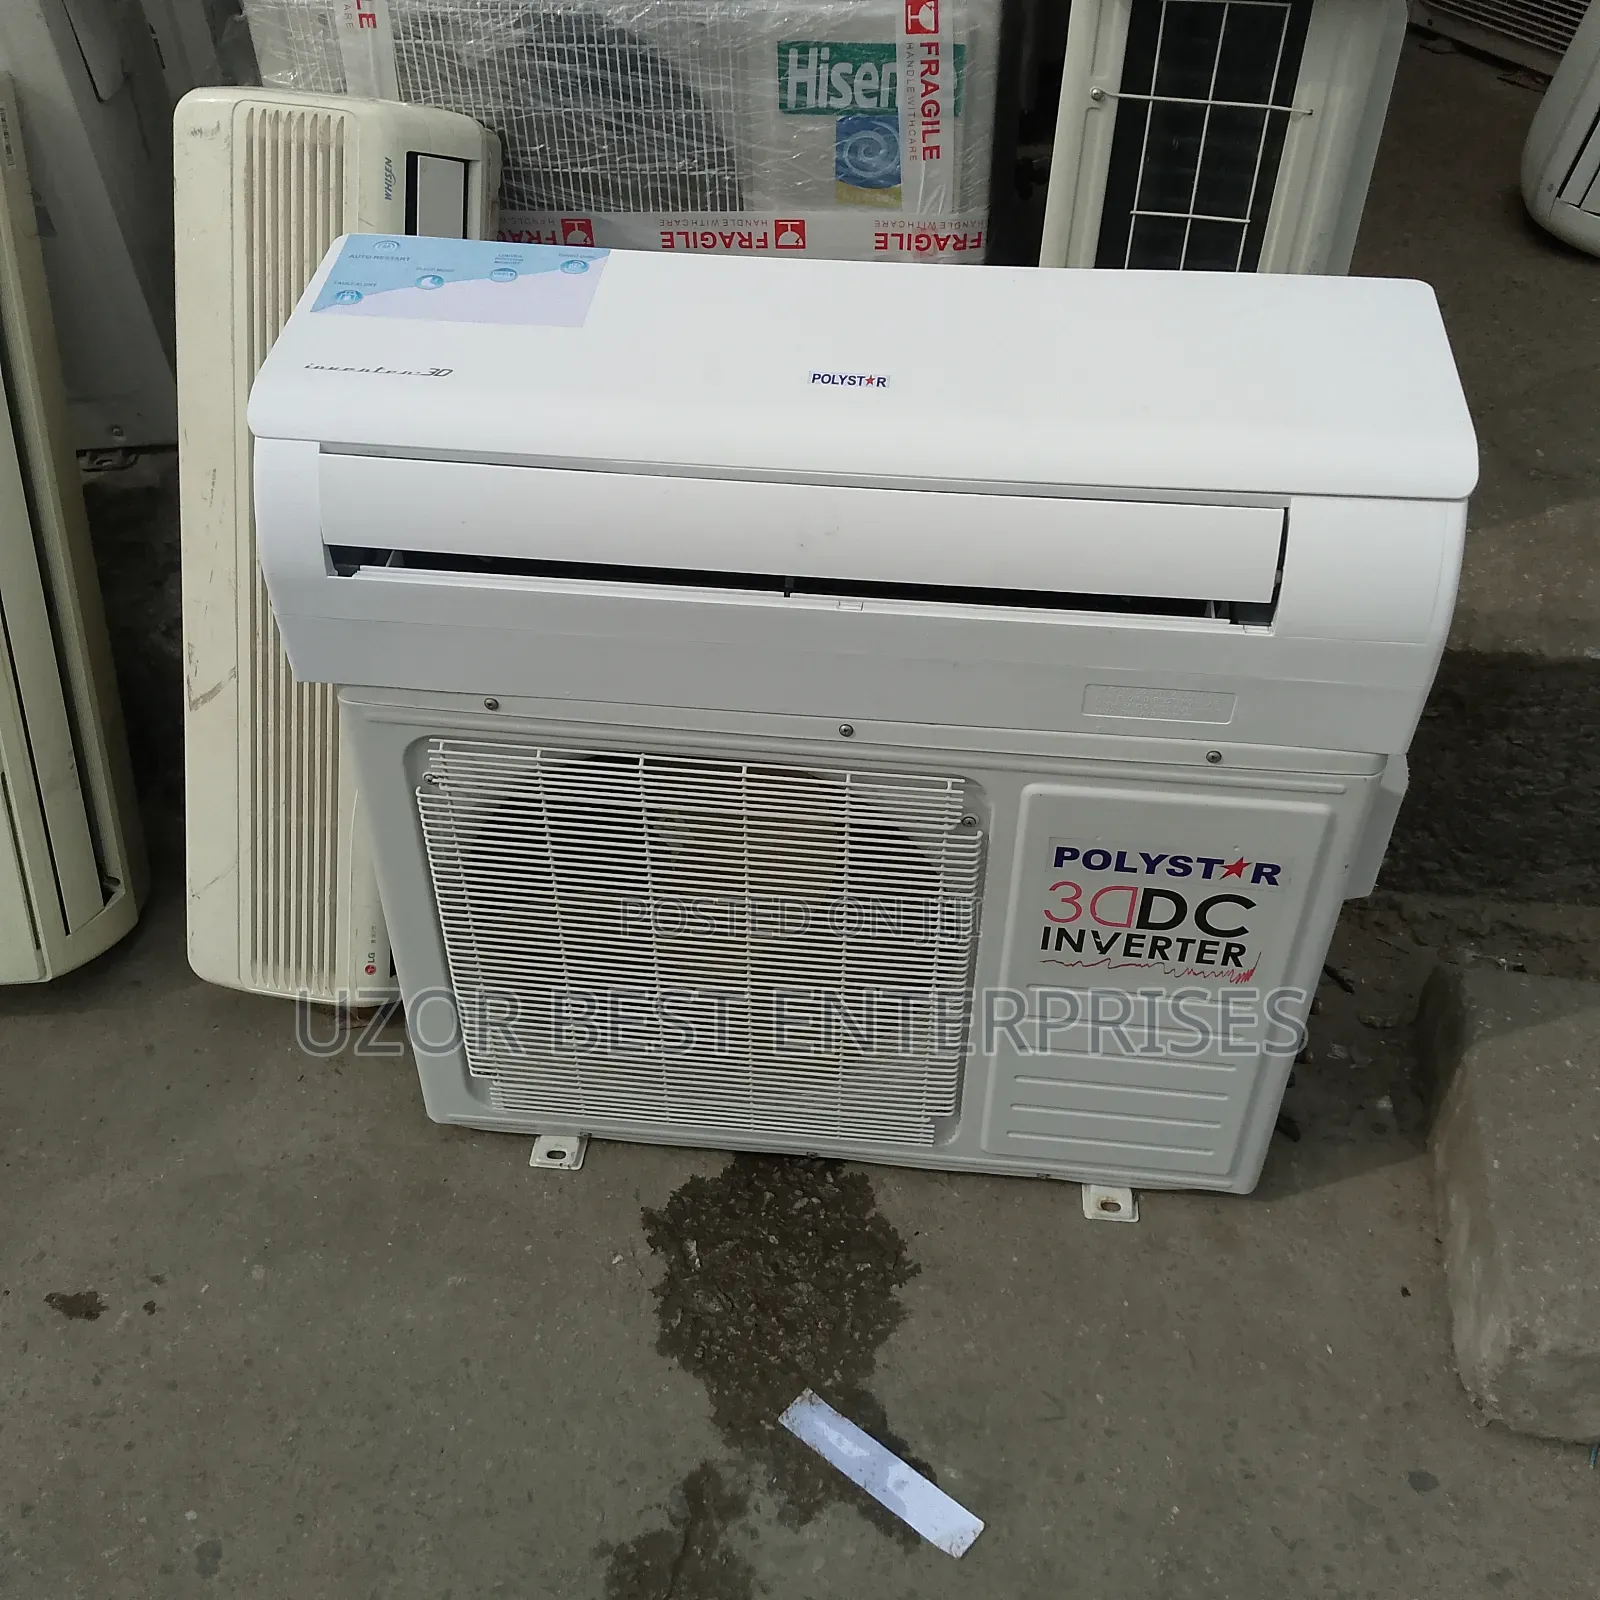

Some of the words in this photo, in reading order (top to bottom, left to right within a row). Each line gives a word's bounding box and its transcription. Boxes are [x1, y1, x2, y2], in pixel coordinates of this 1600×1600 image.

[920, 42, 940, 161] FRAGILE
[384, 157, 394, 201] WHISEN
[660, 231, 769, 249] FRAGILE
[874, 231, 983, 251] FRAGILE
[367, 952, 376, 963] LG
[1040, 926, 1247, 968] INVERTER
